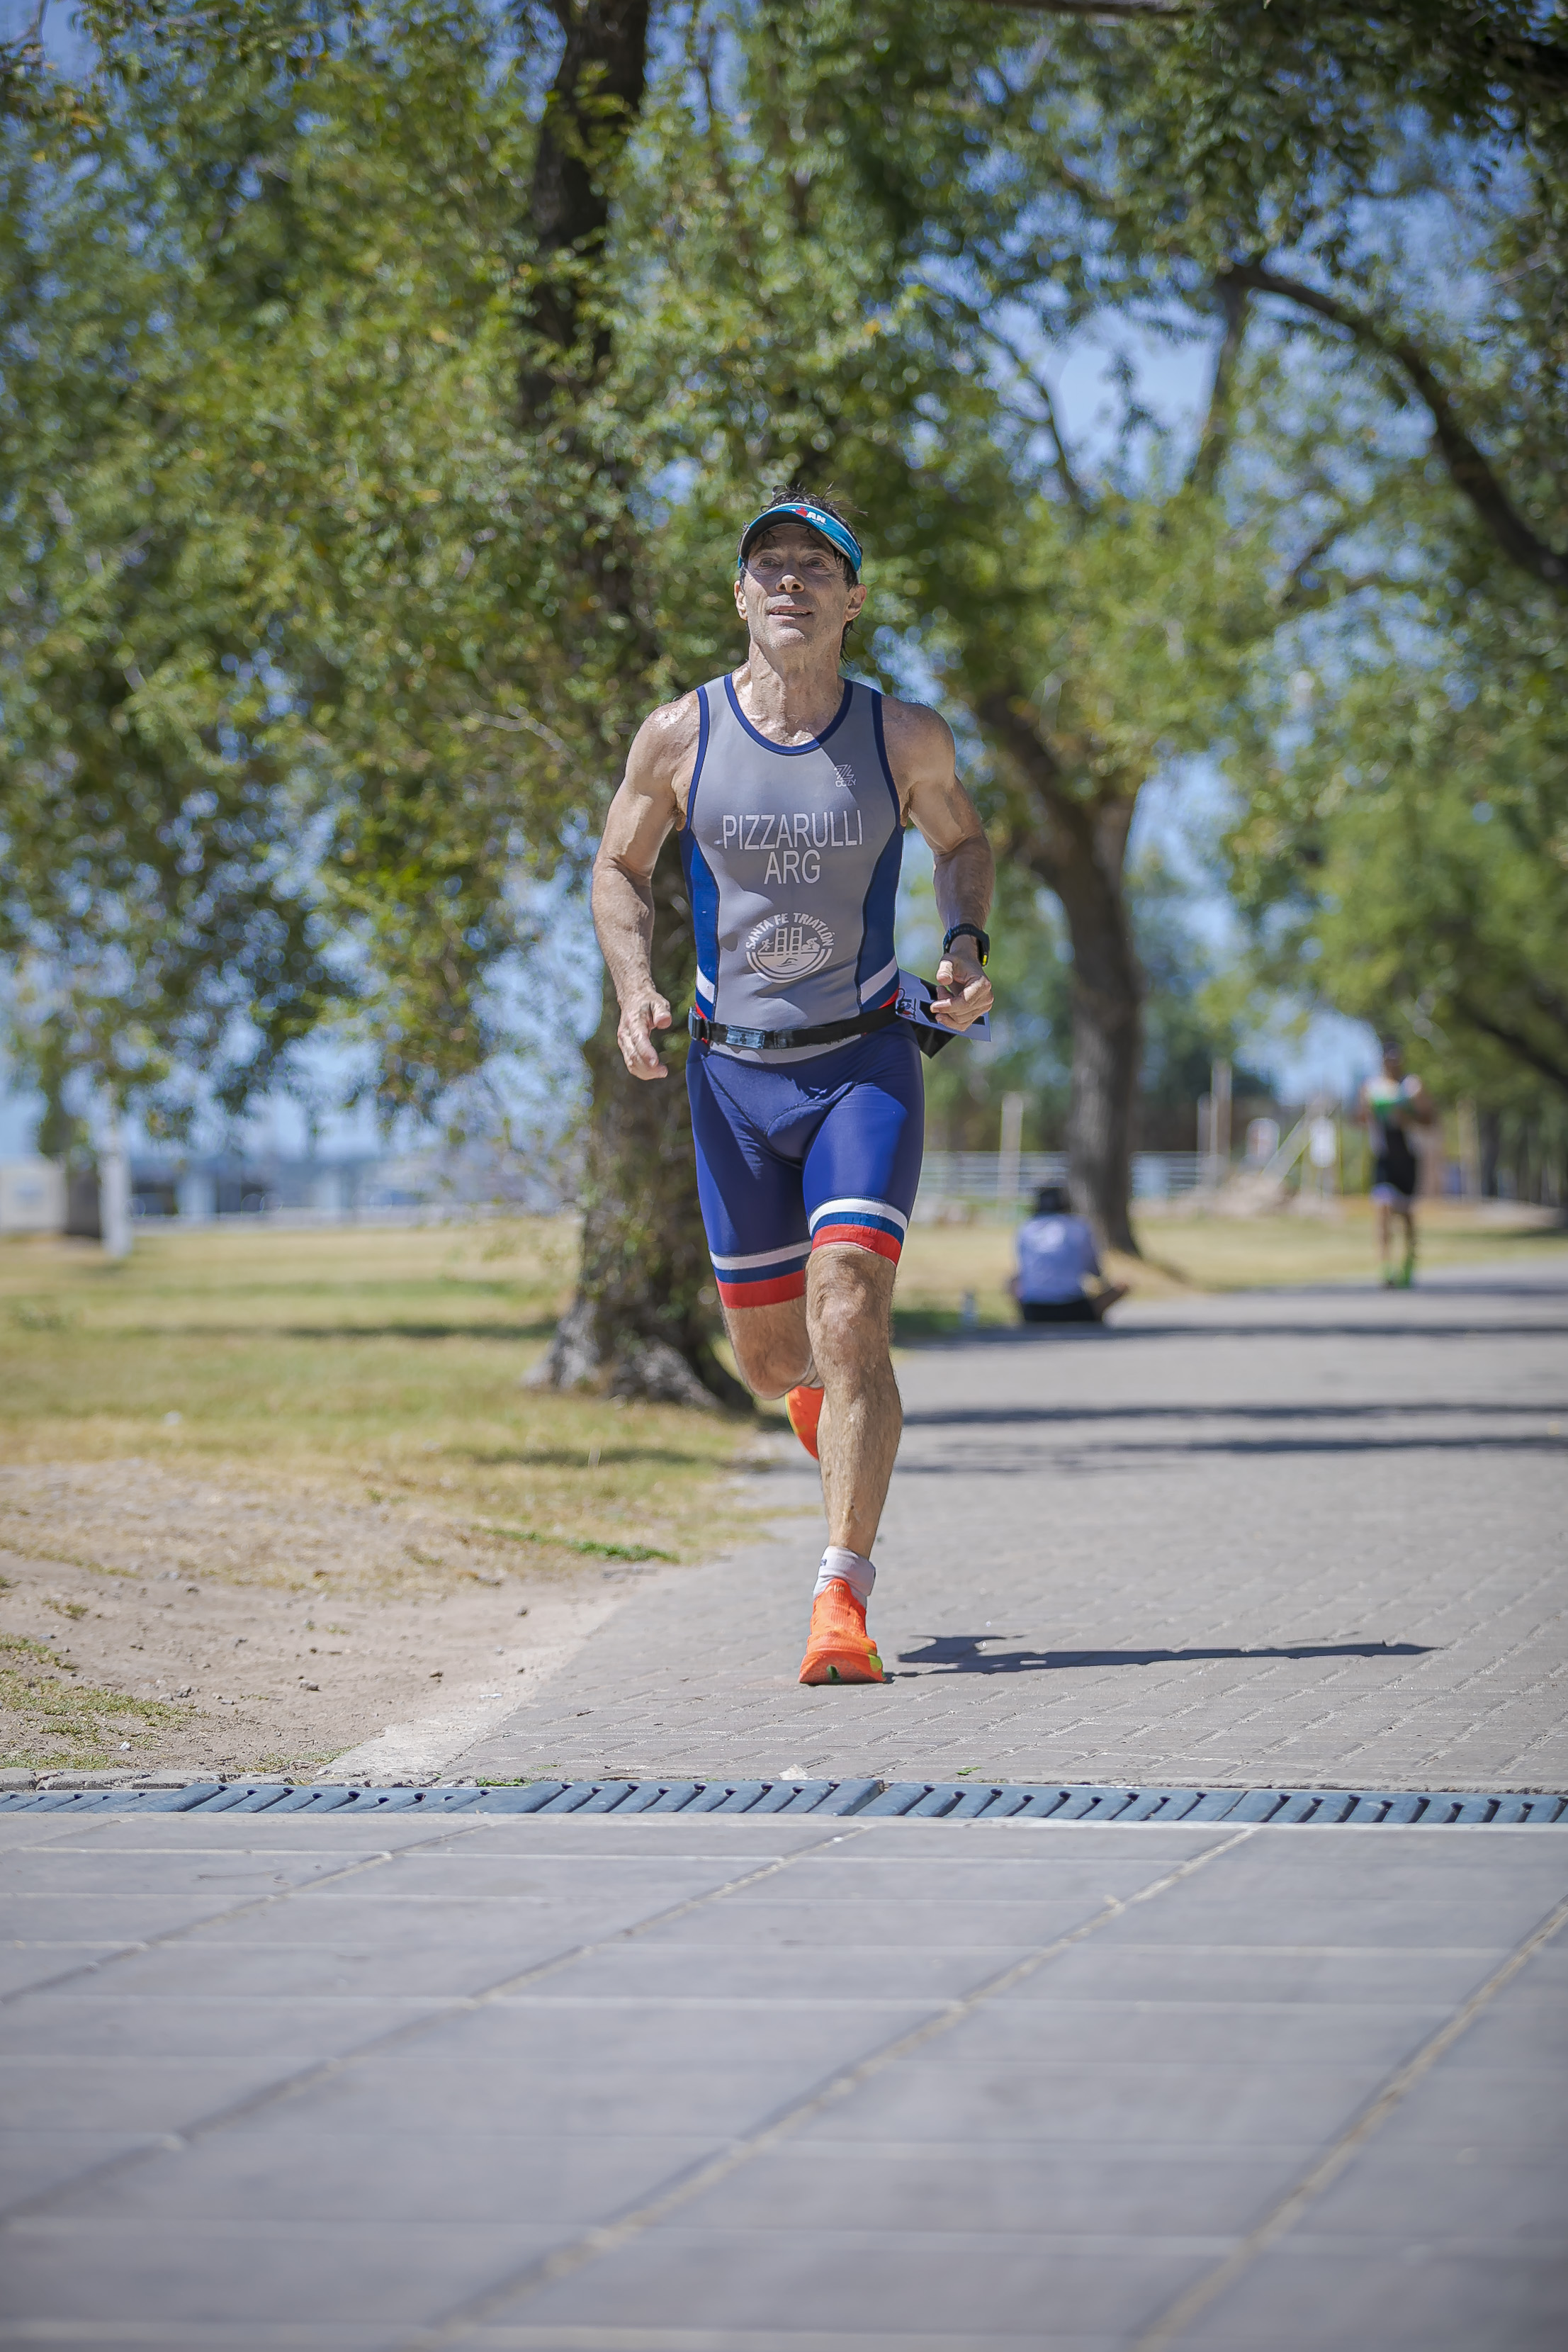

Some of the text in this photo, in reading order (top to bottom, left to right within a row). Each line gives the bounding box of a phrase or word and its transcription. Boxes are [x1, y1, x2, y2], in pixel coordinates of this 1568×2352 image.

[723, 810, 863, 850] PIZZARULLI
[764, 850, 821, 884] ARG
[745, 913, 835, 949] SANTA FE TRIATLÓN
